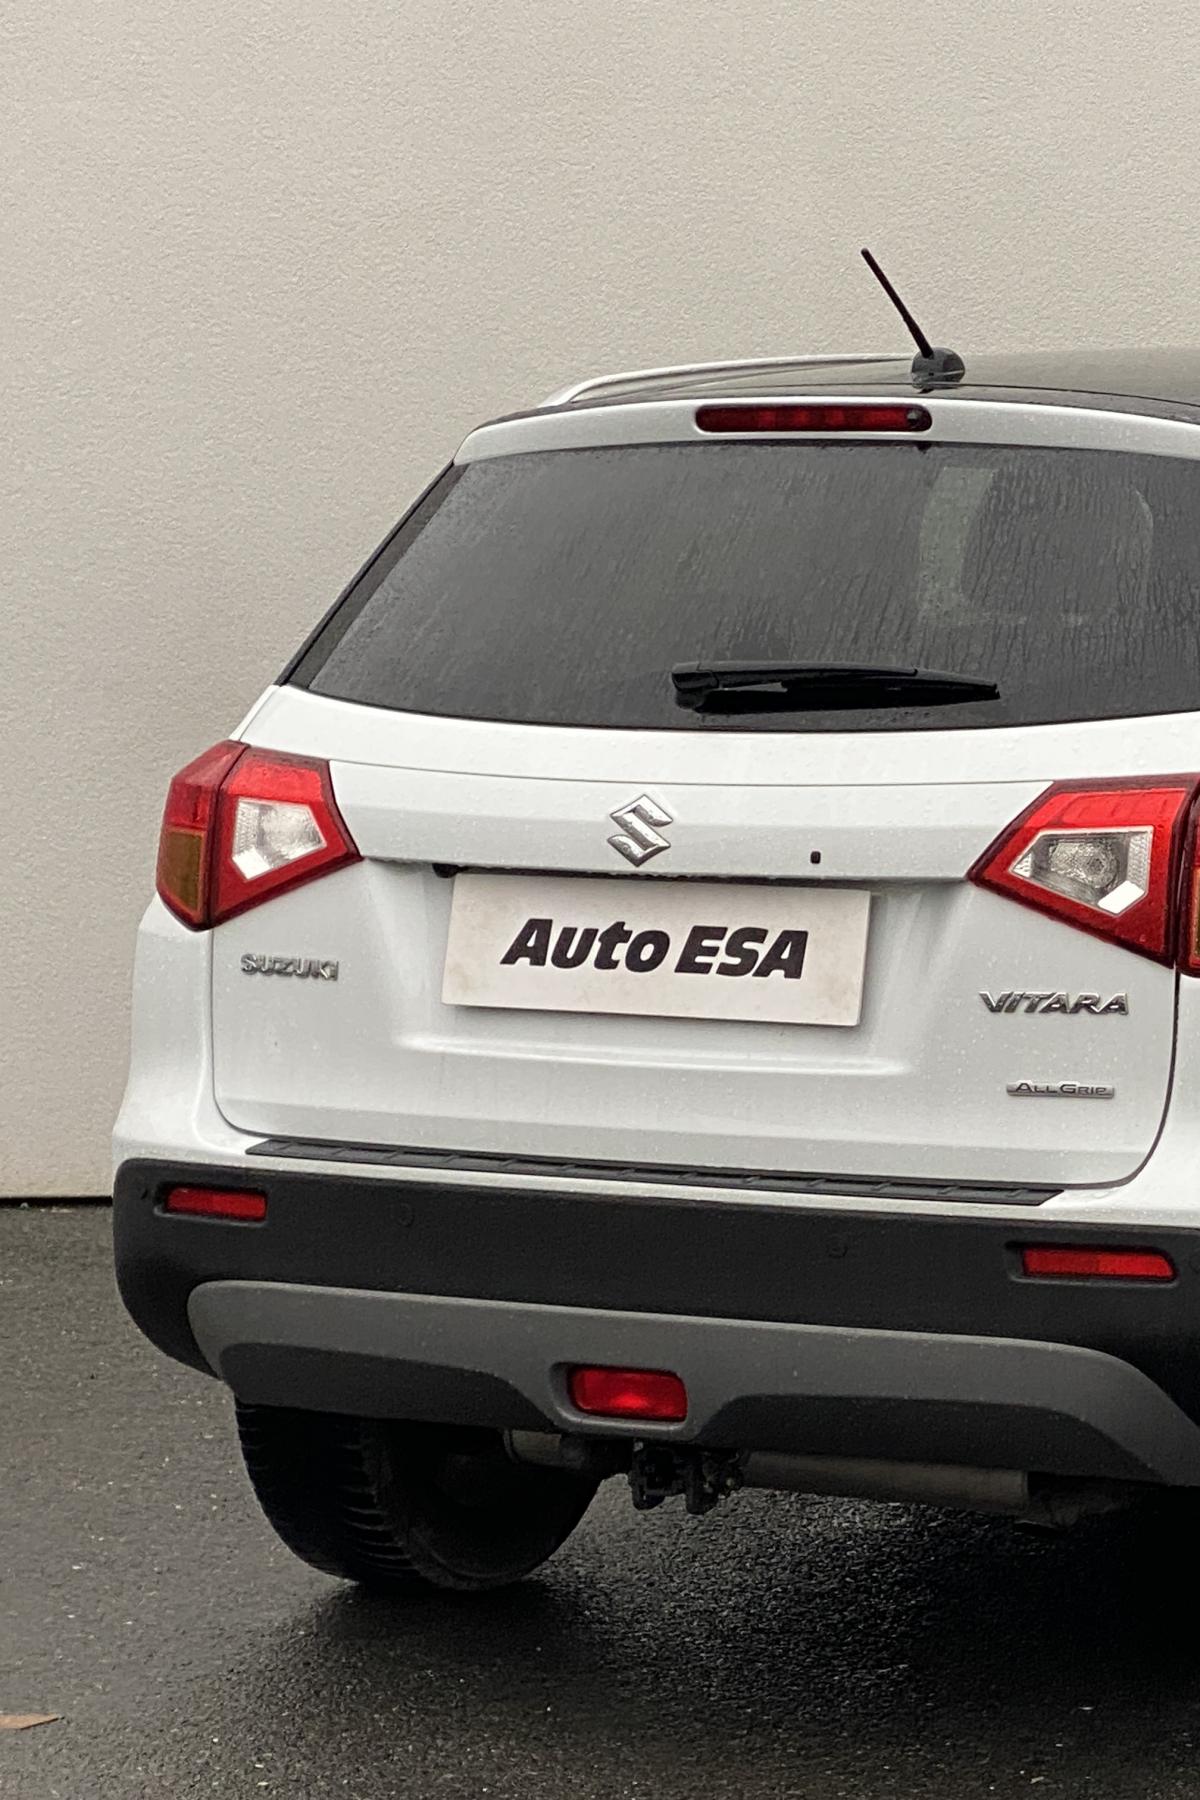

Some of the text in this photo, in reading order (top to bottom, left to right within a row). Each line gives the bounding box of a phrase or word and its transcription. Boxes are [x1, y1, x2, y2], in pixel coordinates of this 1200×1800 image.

[501, 918, 809, 979] Auto ESA
[240, 953, 339, 981] SUZUKI
[979, 991, 1129, 1015] VITARA
